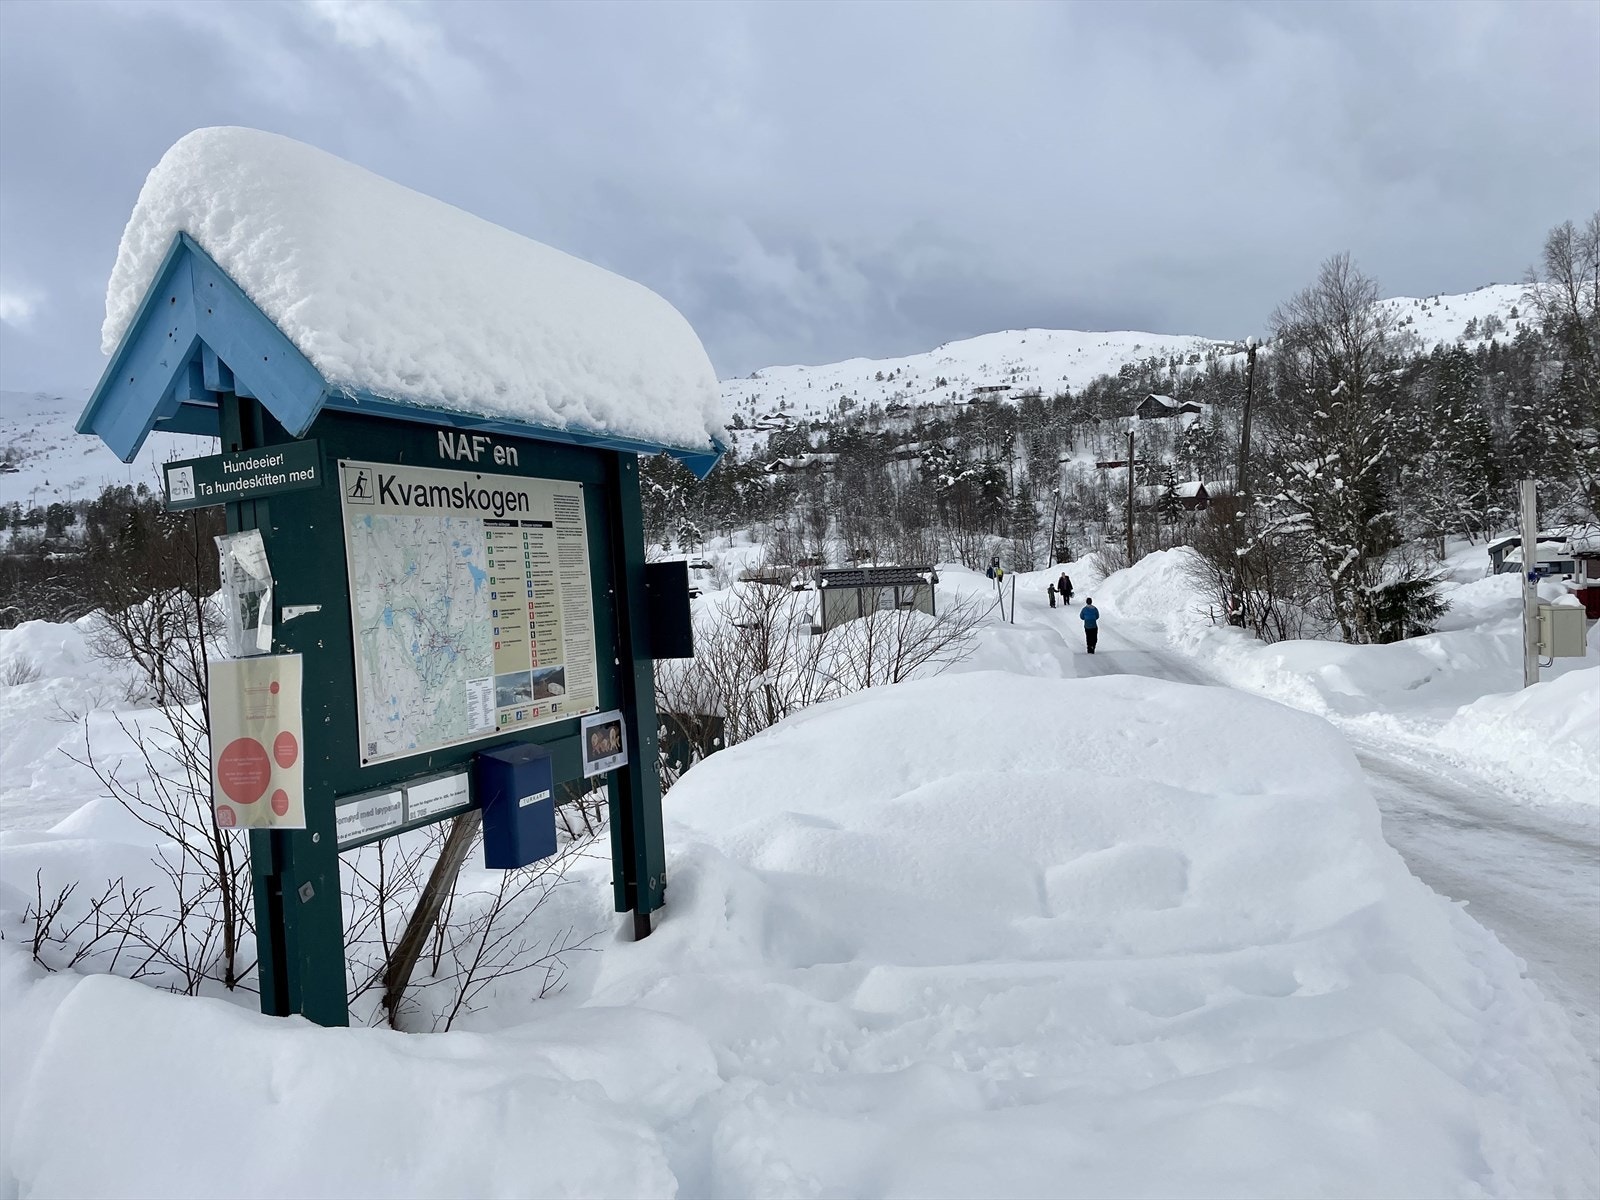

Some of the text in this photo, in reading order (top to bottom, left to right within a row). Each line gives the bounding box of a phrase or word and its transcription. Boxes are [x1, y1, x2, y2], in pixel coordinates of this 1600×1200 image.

[222, 453, 284, 474] Hundeeier!
[199, 466, 315, 496] Ta hundeskitten med
[377, 473, 530, 517] Kvamskogen
[361, 807, 374, 820] med
